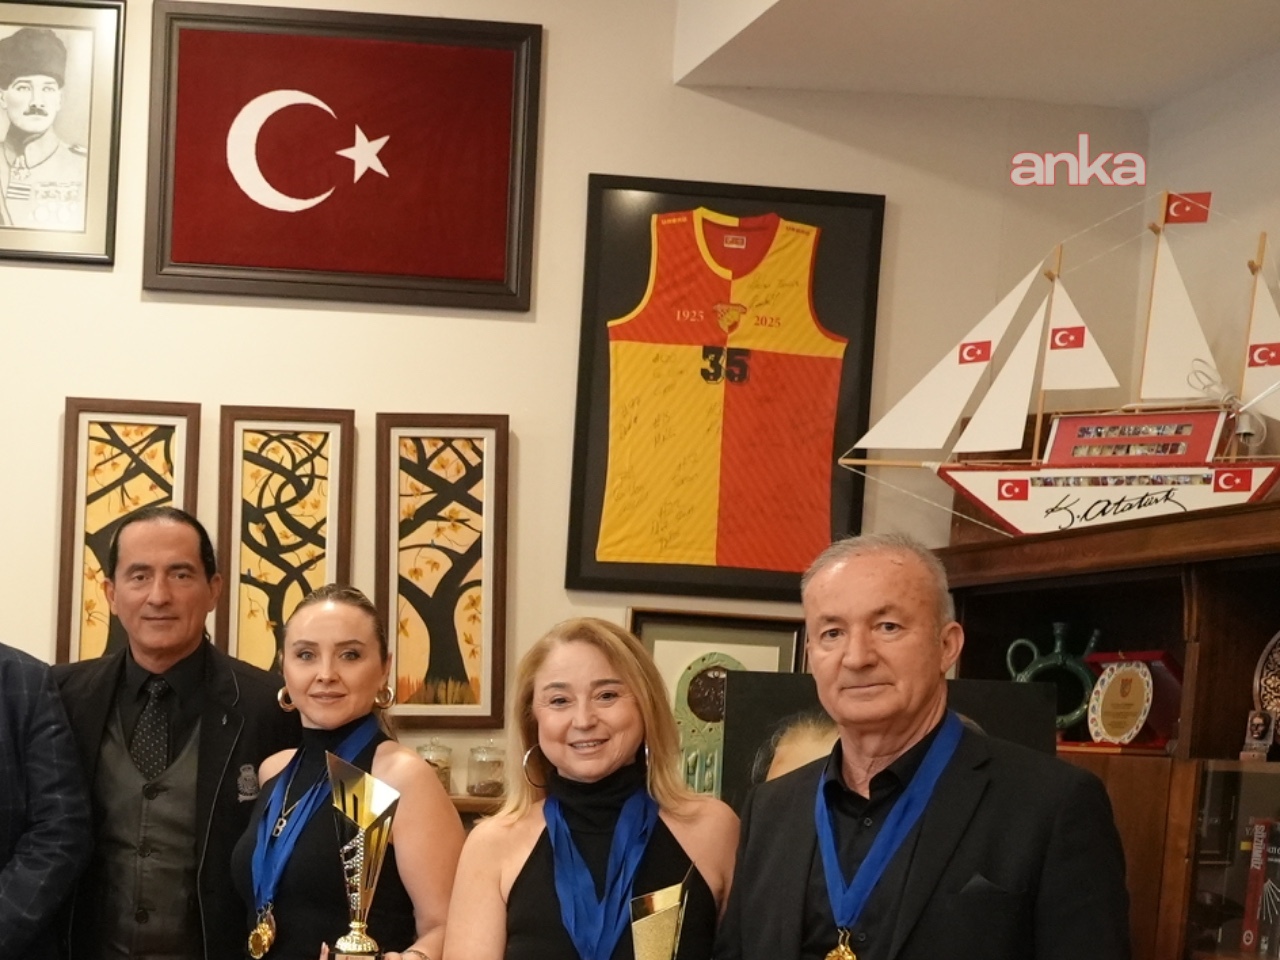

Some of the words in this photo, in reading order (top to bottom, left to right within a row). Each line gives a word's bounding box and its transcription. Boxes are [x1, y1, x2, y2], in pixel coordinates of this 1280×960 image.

[675, 309, 705, 322] 1925
[753, 315, 782, 328] 2025
[700, 345, 752, 385] 35
